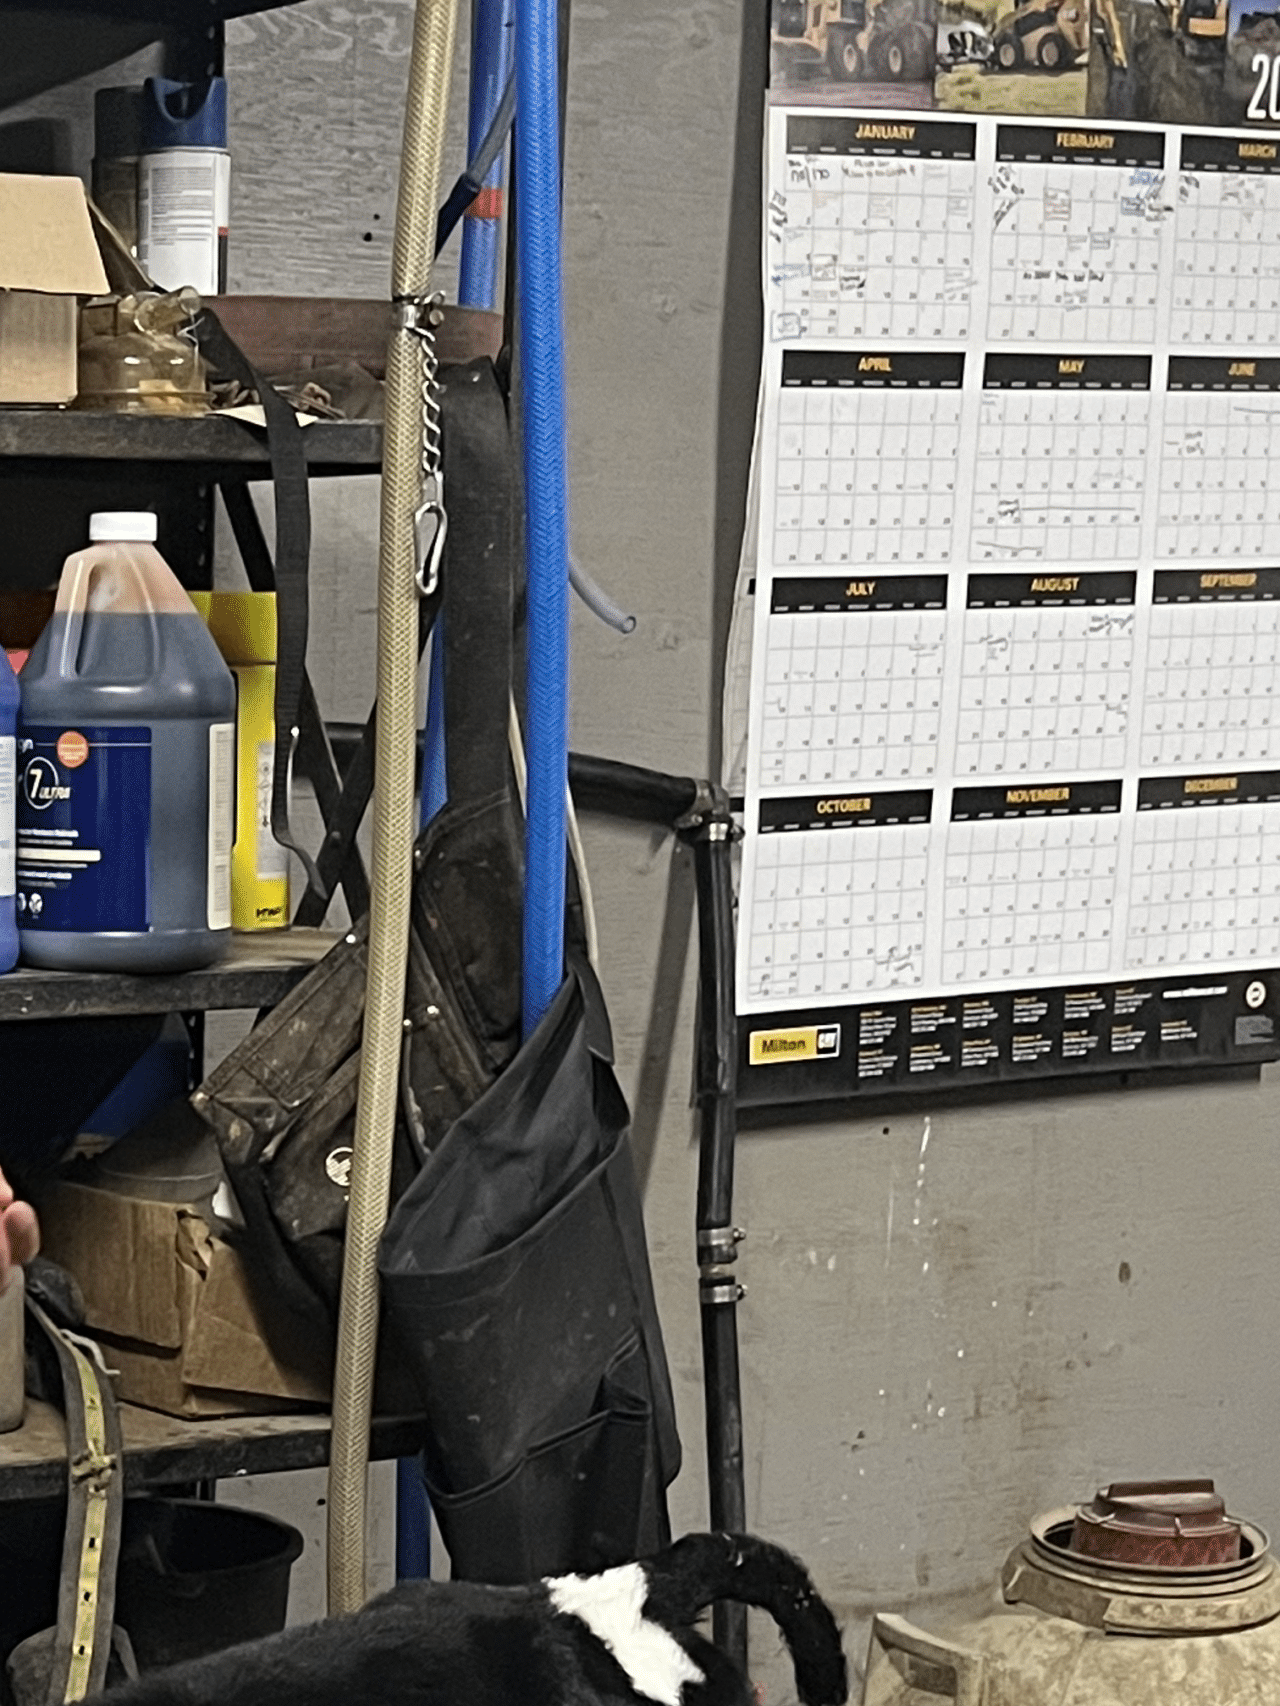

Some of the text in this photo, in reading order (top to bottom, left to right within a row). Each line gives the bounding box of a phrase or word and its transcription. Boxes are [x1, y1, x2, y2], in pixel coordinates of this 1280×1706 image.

[855, 124, 915, 141] JANUARY
[1056, 132, 1115, 149] FEBRUARY
[1238, 143, 1277, 158] MARCH
[858, 357, 893, 373] APRIL
[1058, 359, 1085, 374] MAY
[1228, 362, 1256, 377] JUNE
[845, 582, 876, 596] JULY
[1031, 577, 1080, 592] AUGUST
[29, 768, 43, 799] 7
[1006, 787, 1070, 804] NOVEMBER
[817, 797, 871, 814] OCTOBER
[761, 1038, 807, 1054] Milton
